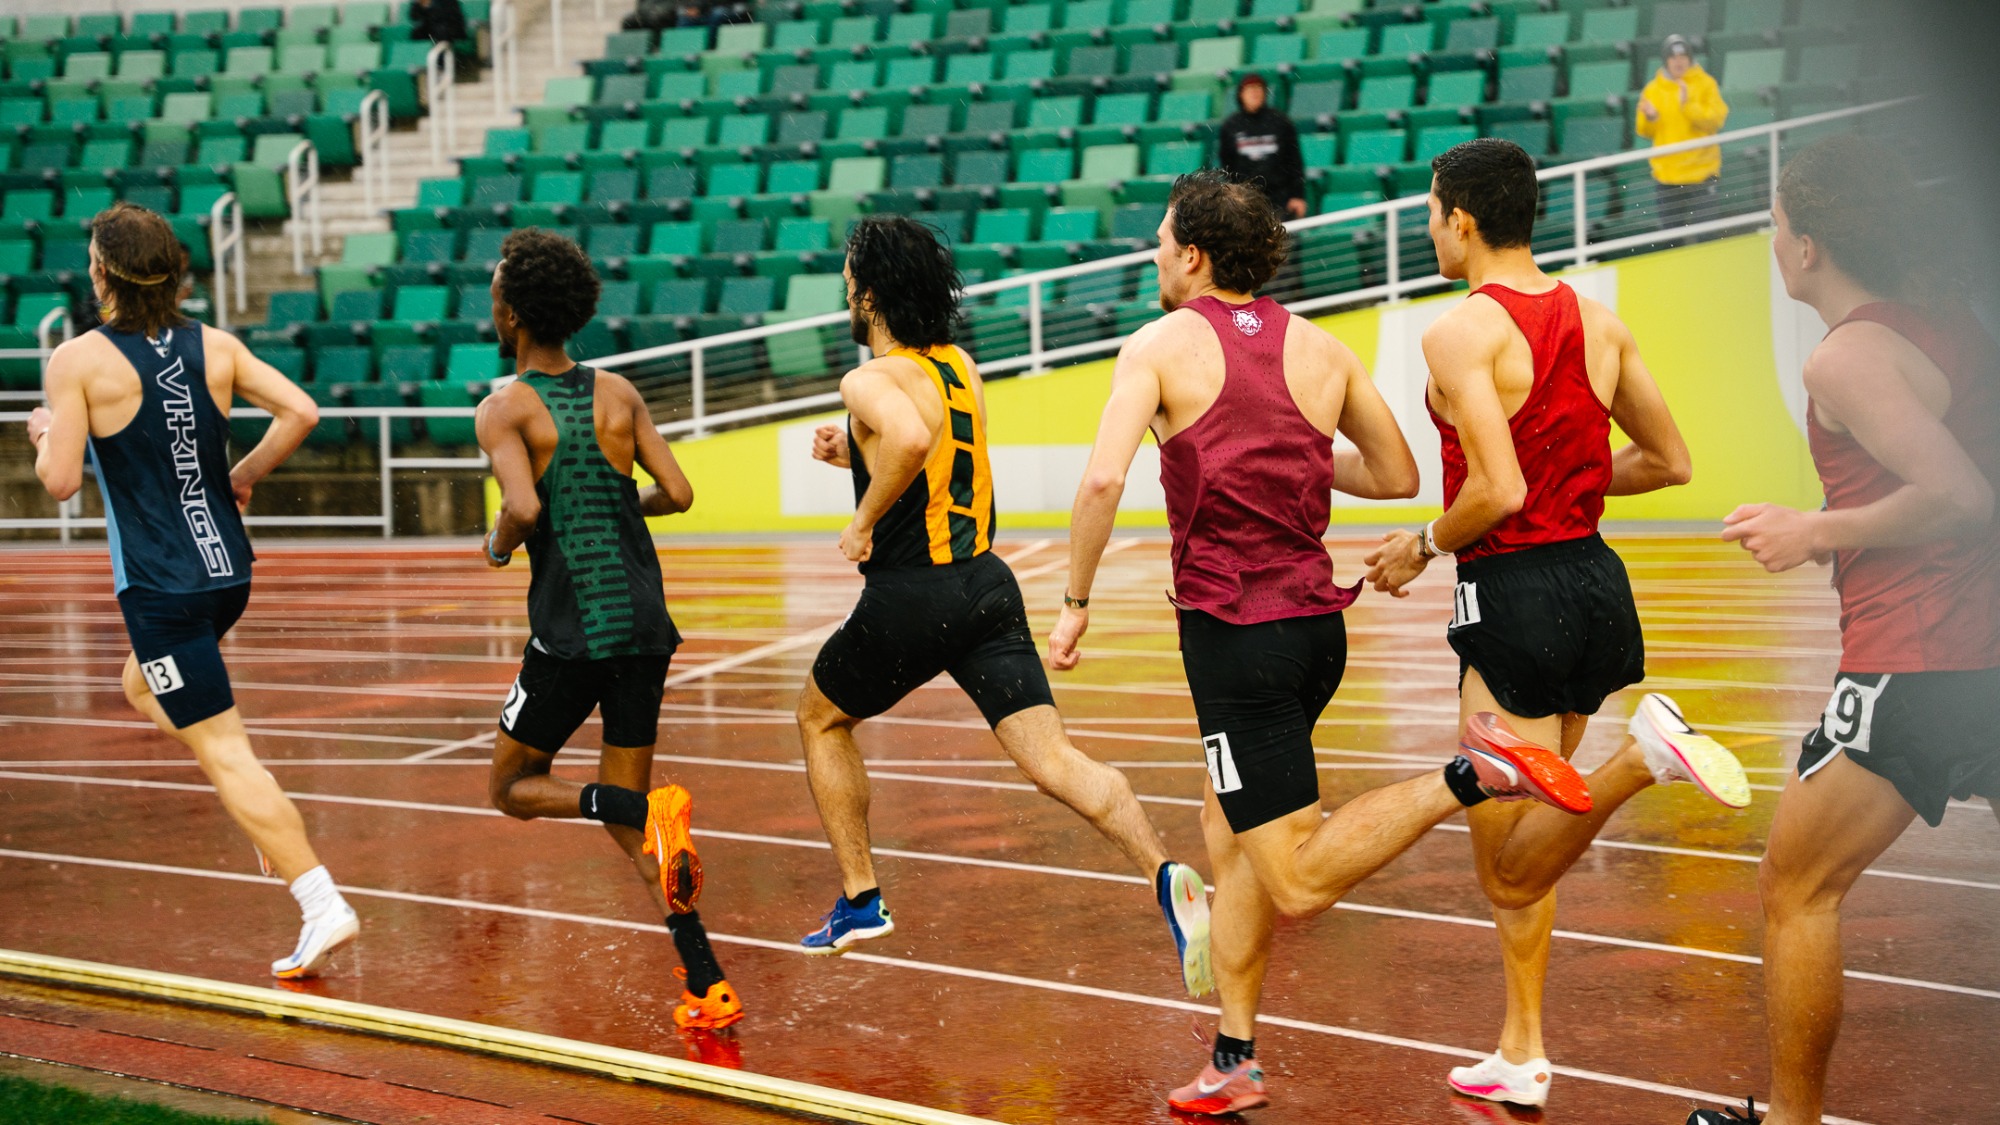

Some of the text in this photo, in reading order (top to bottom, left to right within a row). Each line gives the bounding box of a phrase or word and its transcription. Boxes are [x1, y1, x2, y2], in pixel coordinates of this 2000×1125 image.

[156, 356, 234, 578] VIKINGS
[147, 662, 173, 691] 13
[1834, 686, 1863, 743] 9
[1205, 738, 1226, 790] 7
